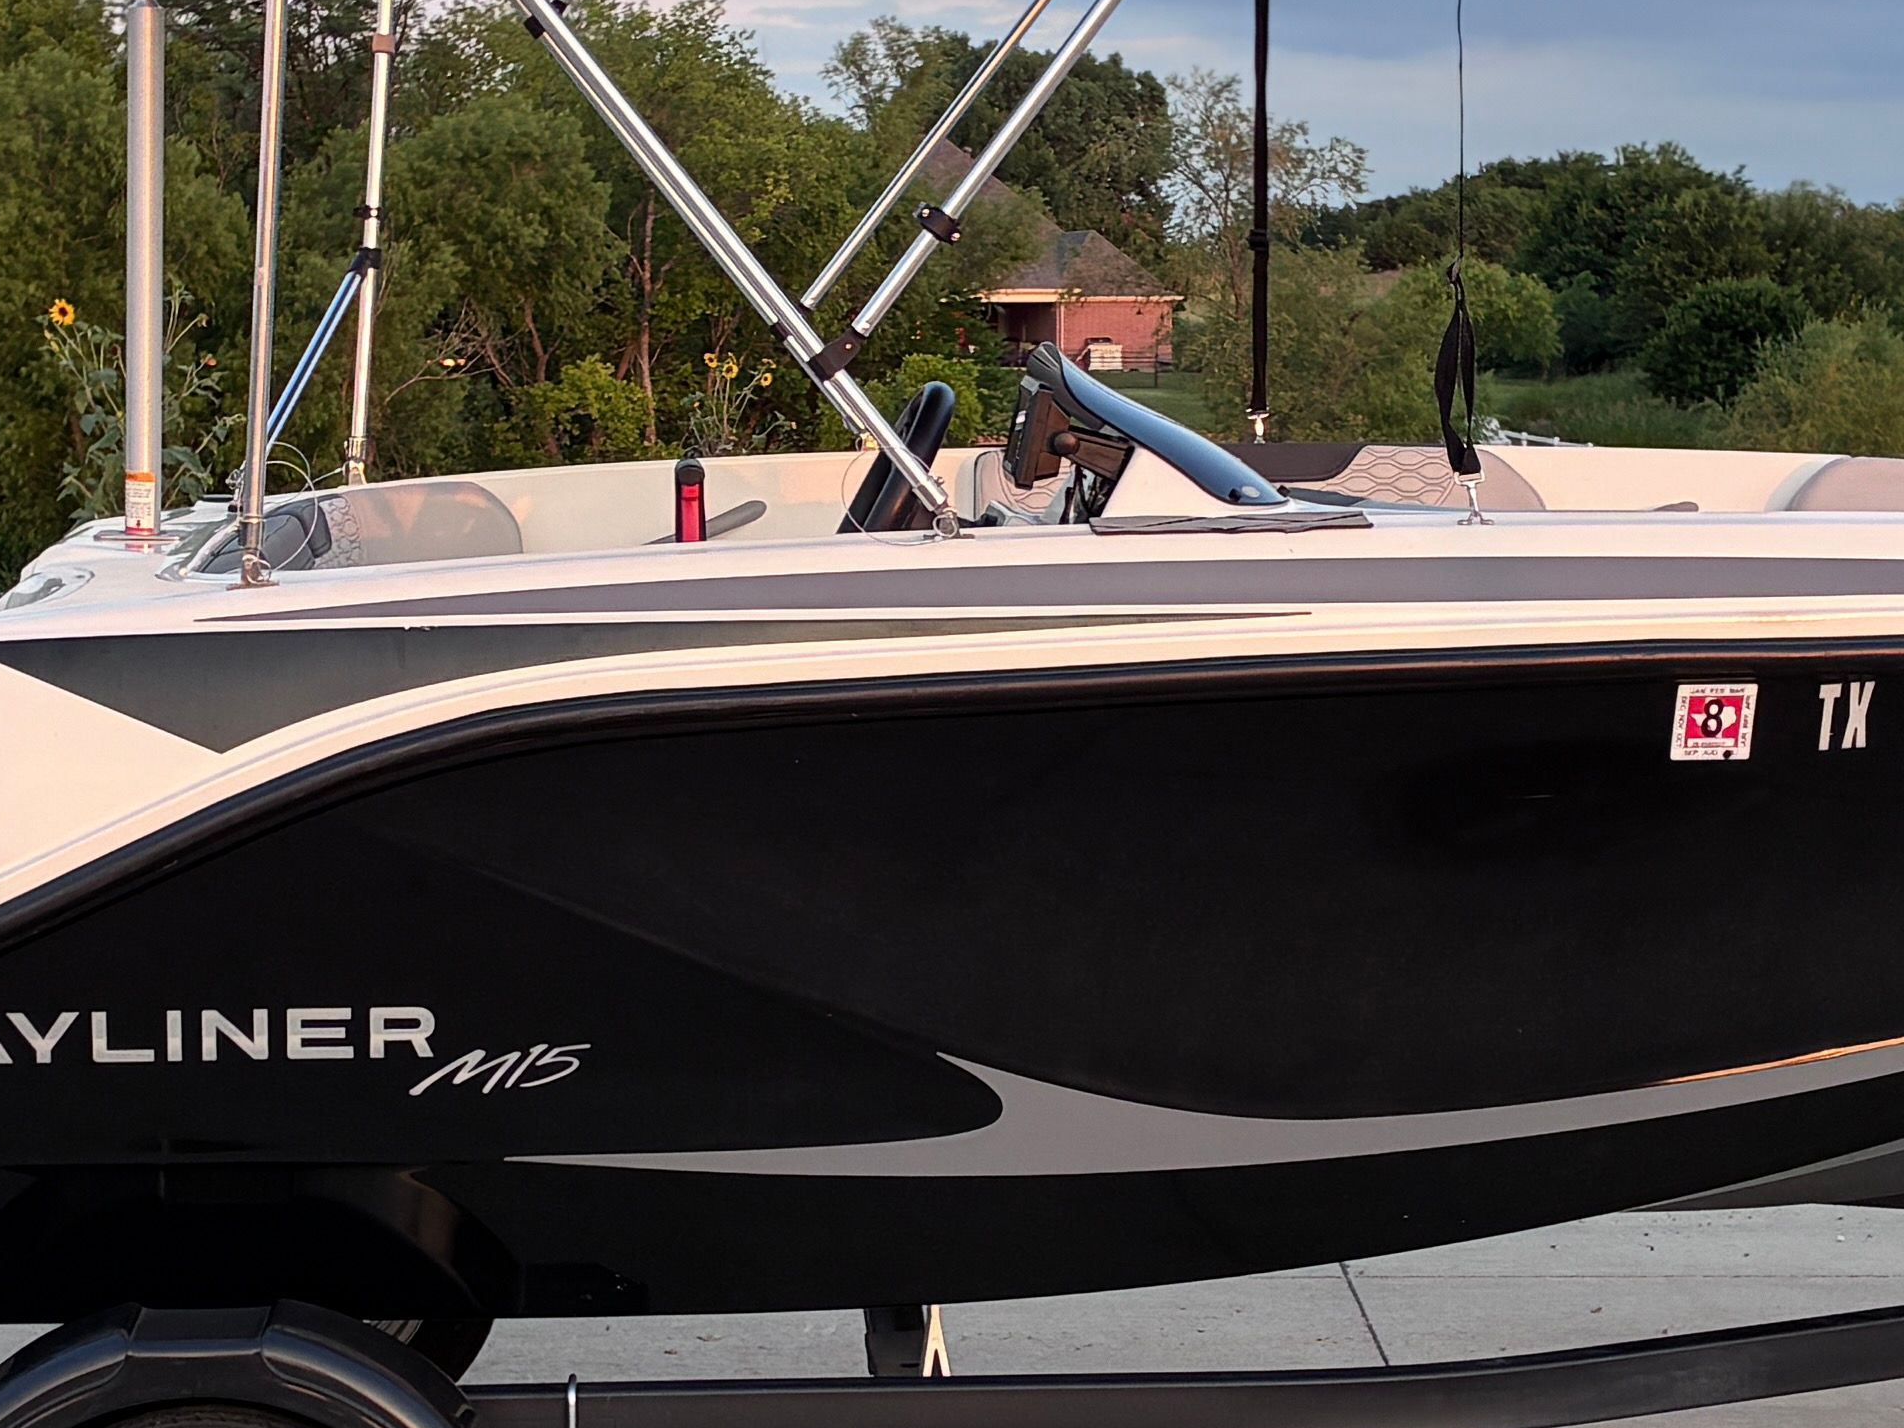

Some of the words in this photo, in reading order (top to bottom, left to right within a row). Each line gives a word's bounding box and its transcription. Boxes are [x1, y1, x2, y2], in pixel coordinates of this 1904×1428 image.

[1700, 698, 1725, 739] 8
[1818, 681, 1876, 751] TX
[407, 1043, 592, 1096] M15
